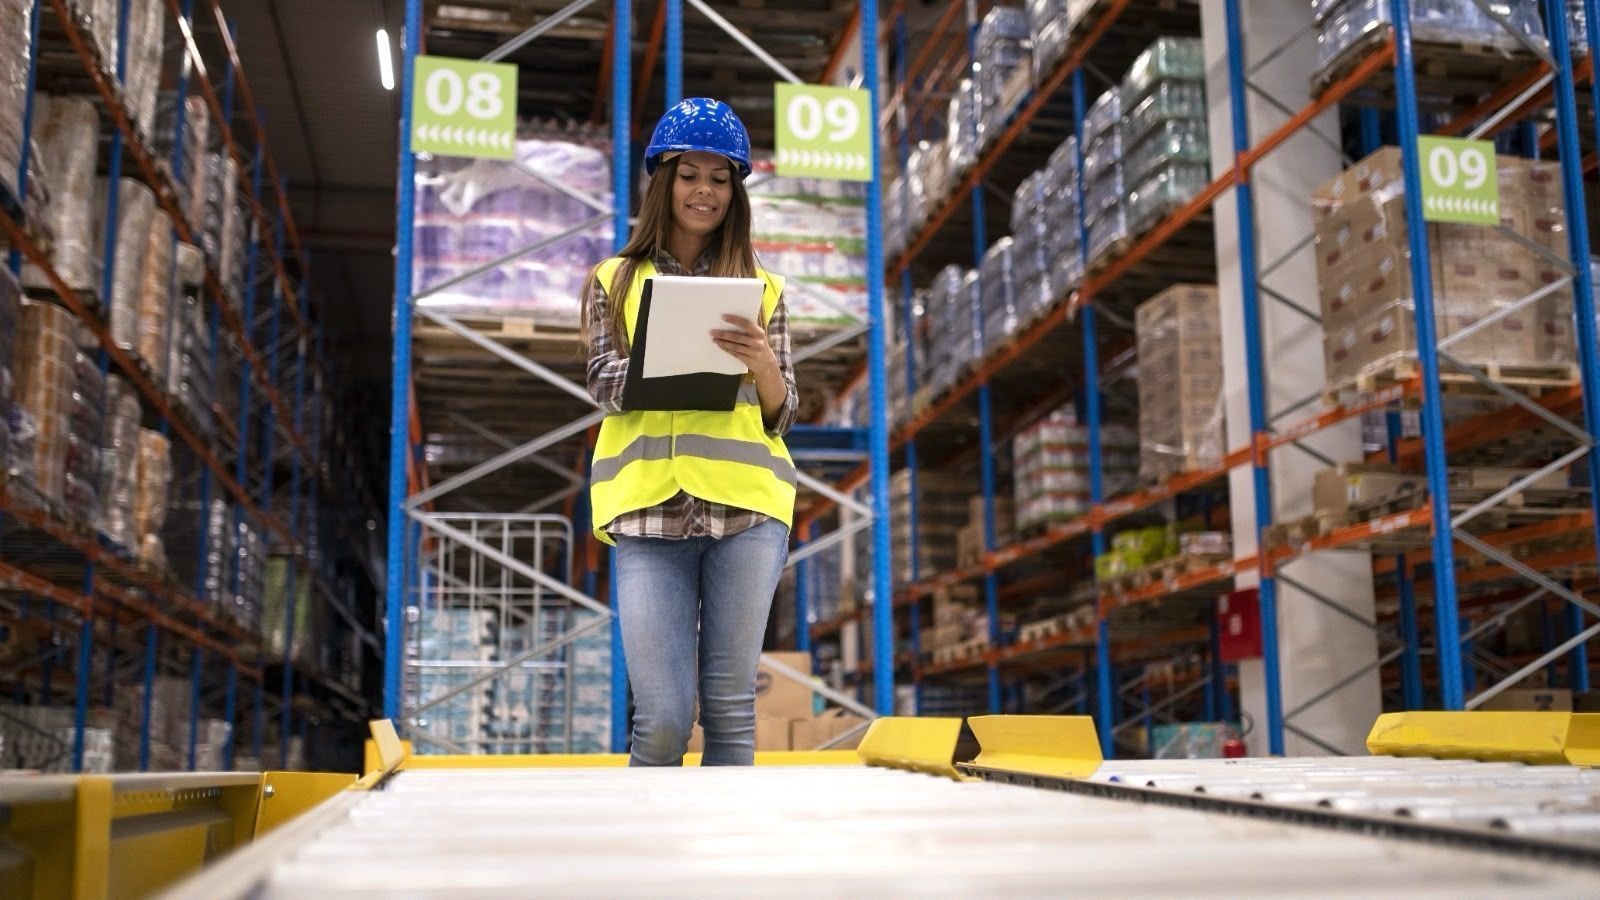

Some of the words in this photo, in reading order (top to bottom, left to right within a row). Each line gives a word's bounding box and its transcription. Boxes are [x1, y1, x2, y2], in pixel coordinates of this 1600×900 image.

[425, 68, 504, 119] 08
[786, 94, 861, 142] 09
[1428, 146, 1488, 189] 09
